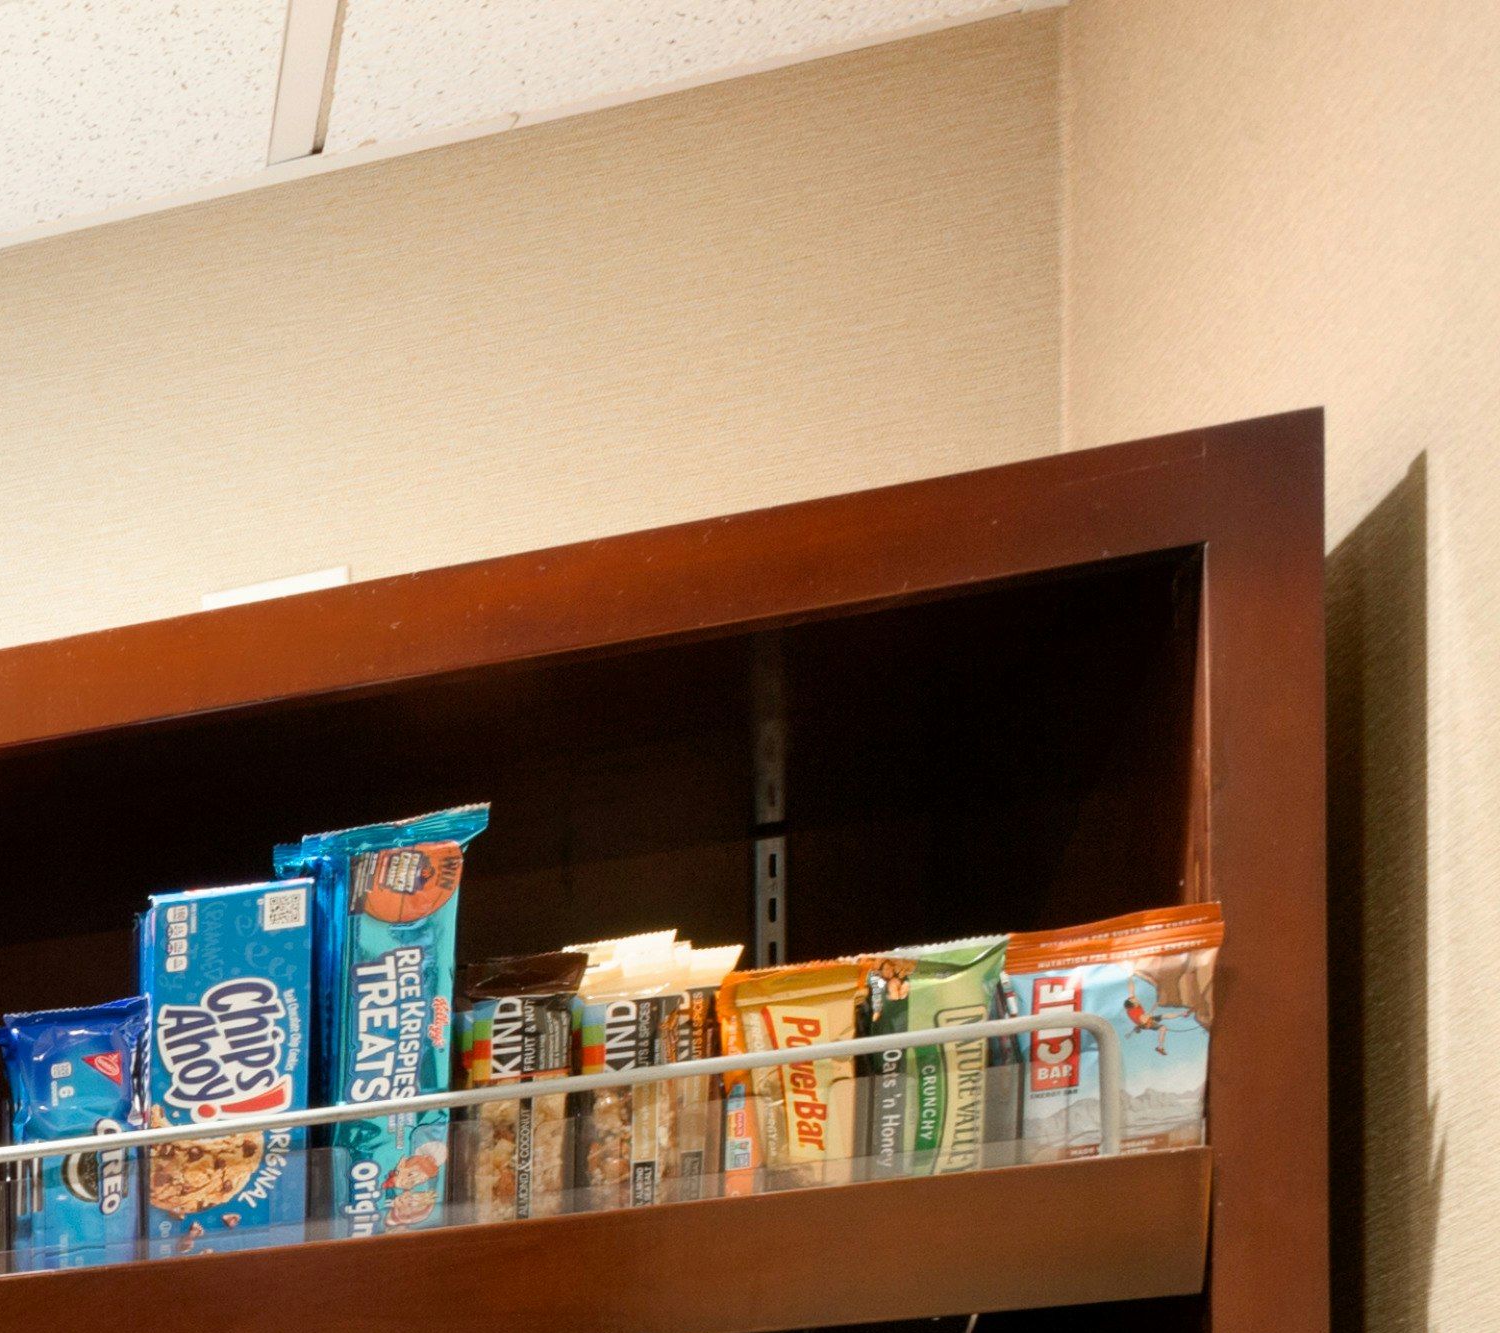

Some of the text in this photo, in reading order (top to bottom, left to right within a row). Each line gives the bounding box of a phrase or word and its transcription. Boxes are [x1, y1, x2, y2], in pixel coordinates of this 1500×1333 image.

[207, 982, 283, 1091] Chips
[351, 956, 397, 1103] TREATS
[390, 949, 421, 1101] RICE KRISPIES
[491, 997, 523, 1078] KIND
[605, 1000, 637, 1073] KIND
[1036, 973, 1075, 1064] CLIF
[782, 1016, 827, 1151] PowerBar
[883, 1049, 902, 1089] Oats
[921, 1065, 937, 1141] CRUNCHY
[1037, 1065, 1073, 1081] BAR
[520, 1109, 532, 1152] COCONUT
[877, 1112, 901, 1167] Honey
[519, 1173, 530, 1217] ALMOND
